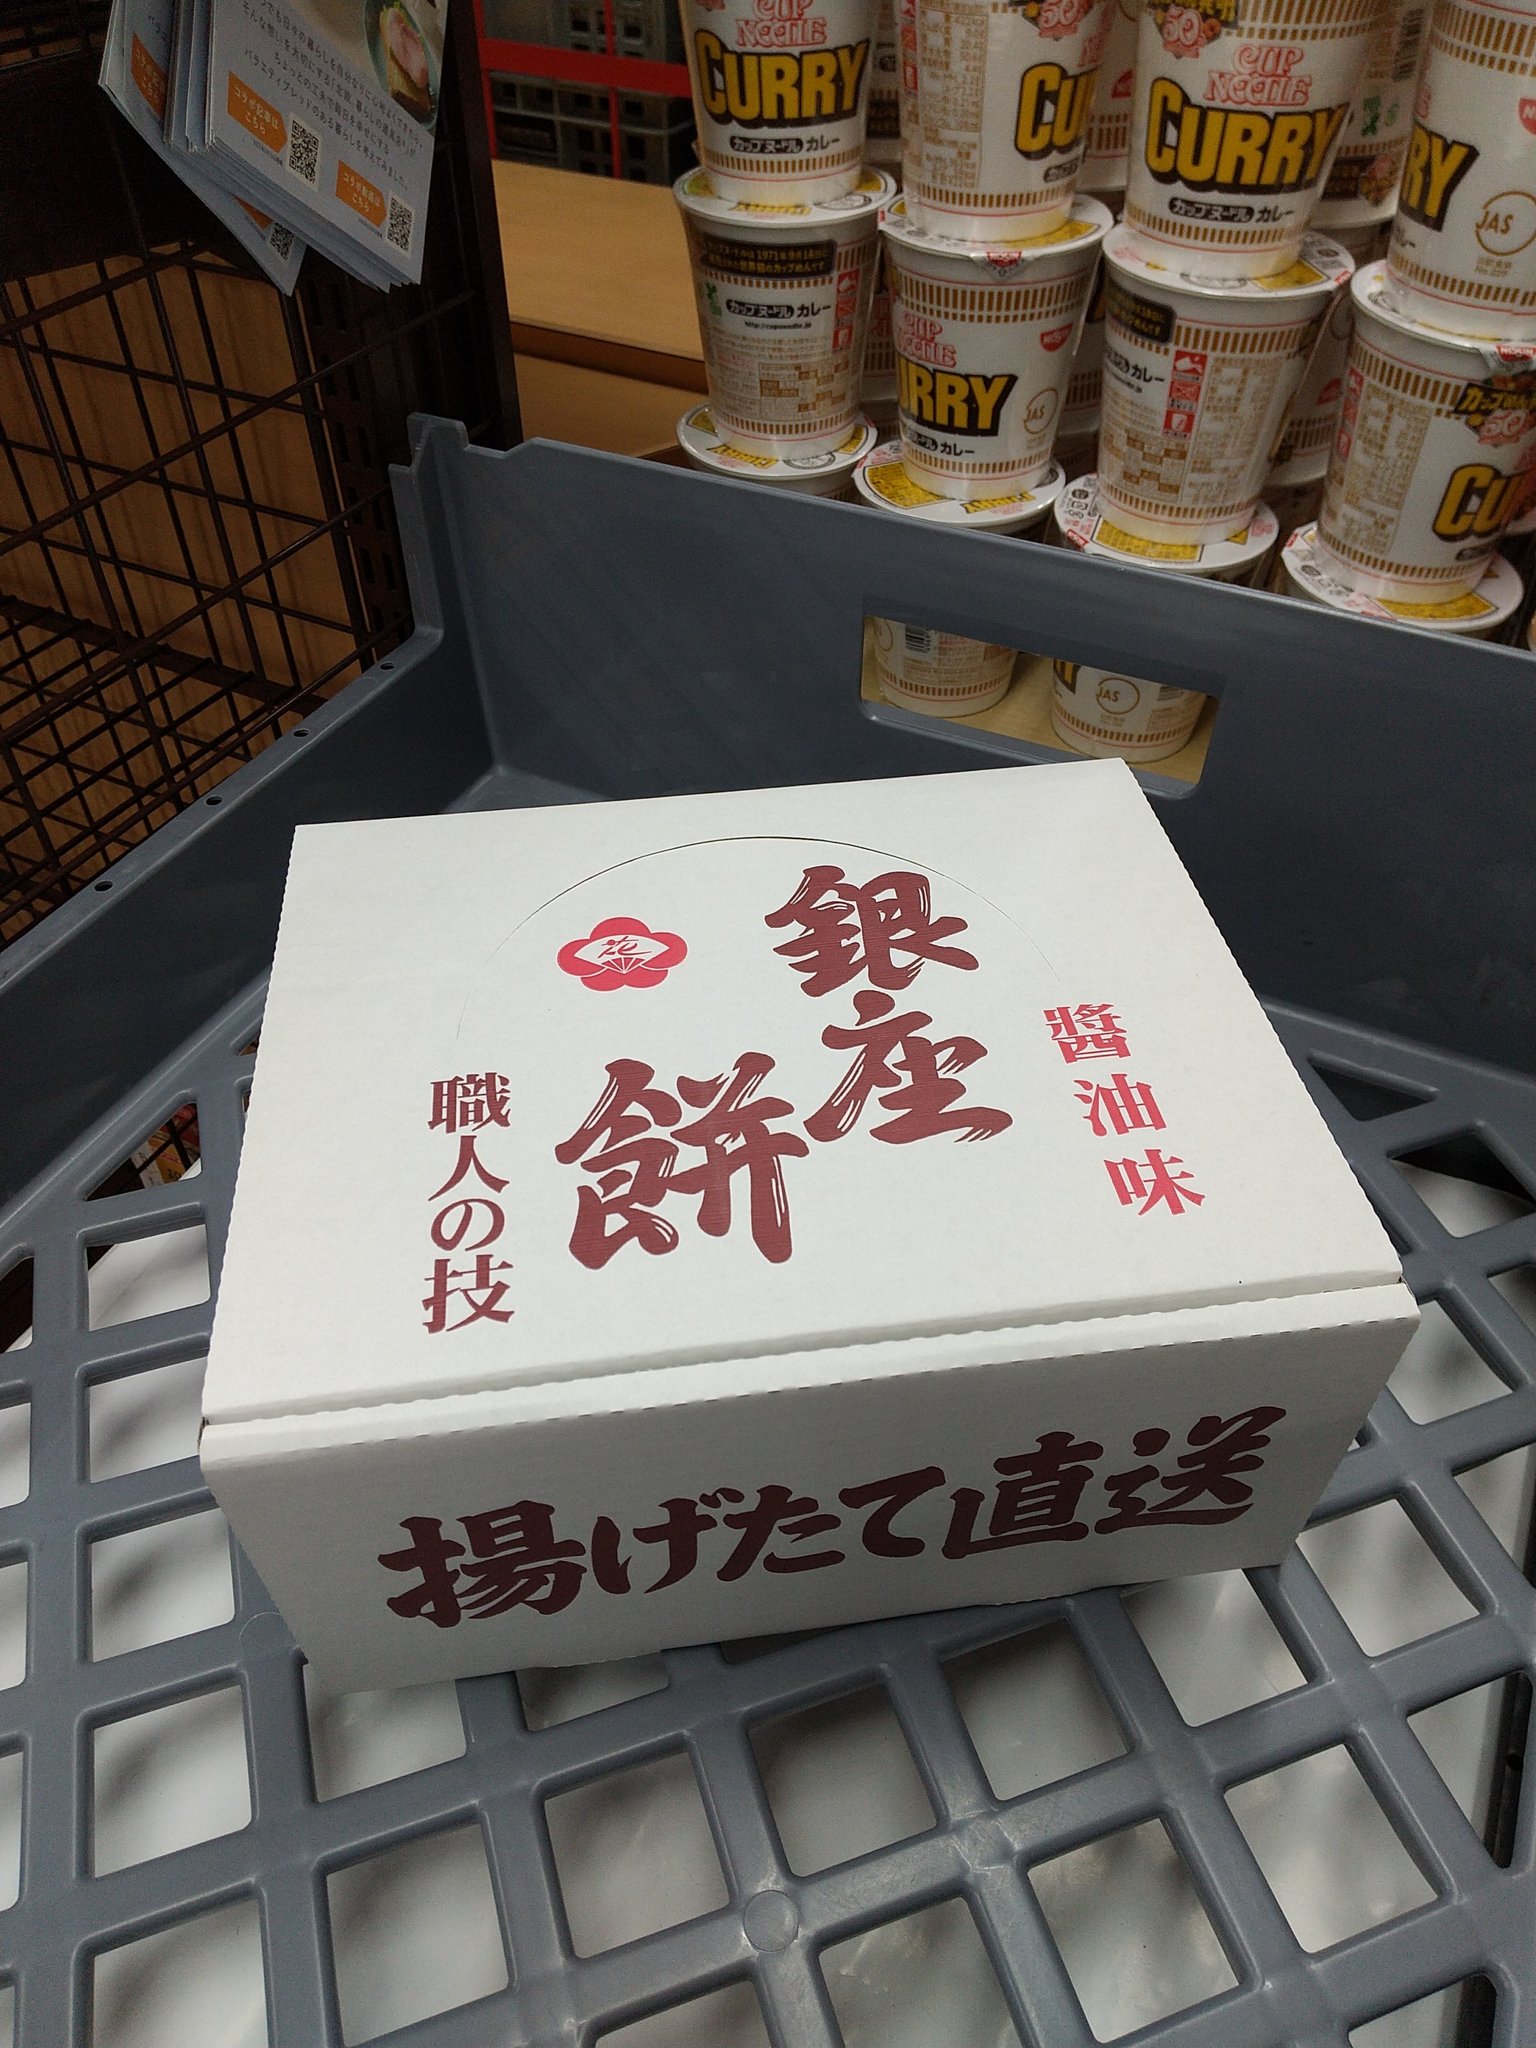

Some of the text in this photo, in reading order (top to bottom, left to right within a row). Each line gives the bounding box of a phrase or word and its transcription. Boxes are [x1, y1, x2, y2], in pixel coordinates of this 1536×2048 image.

[694, 30, 870, 129] CURRY
[1146, 77, 1350, 195] CURRY
[421, 1071, 515, 1335] 職人の技
[376, 1405, 1288, 1630] 揚げたて直送
